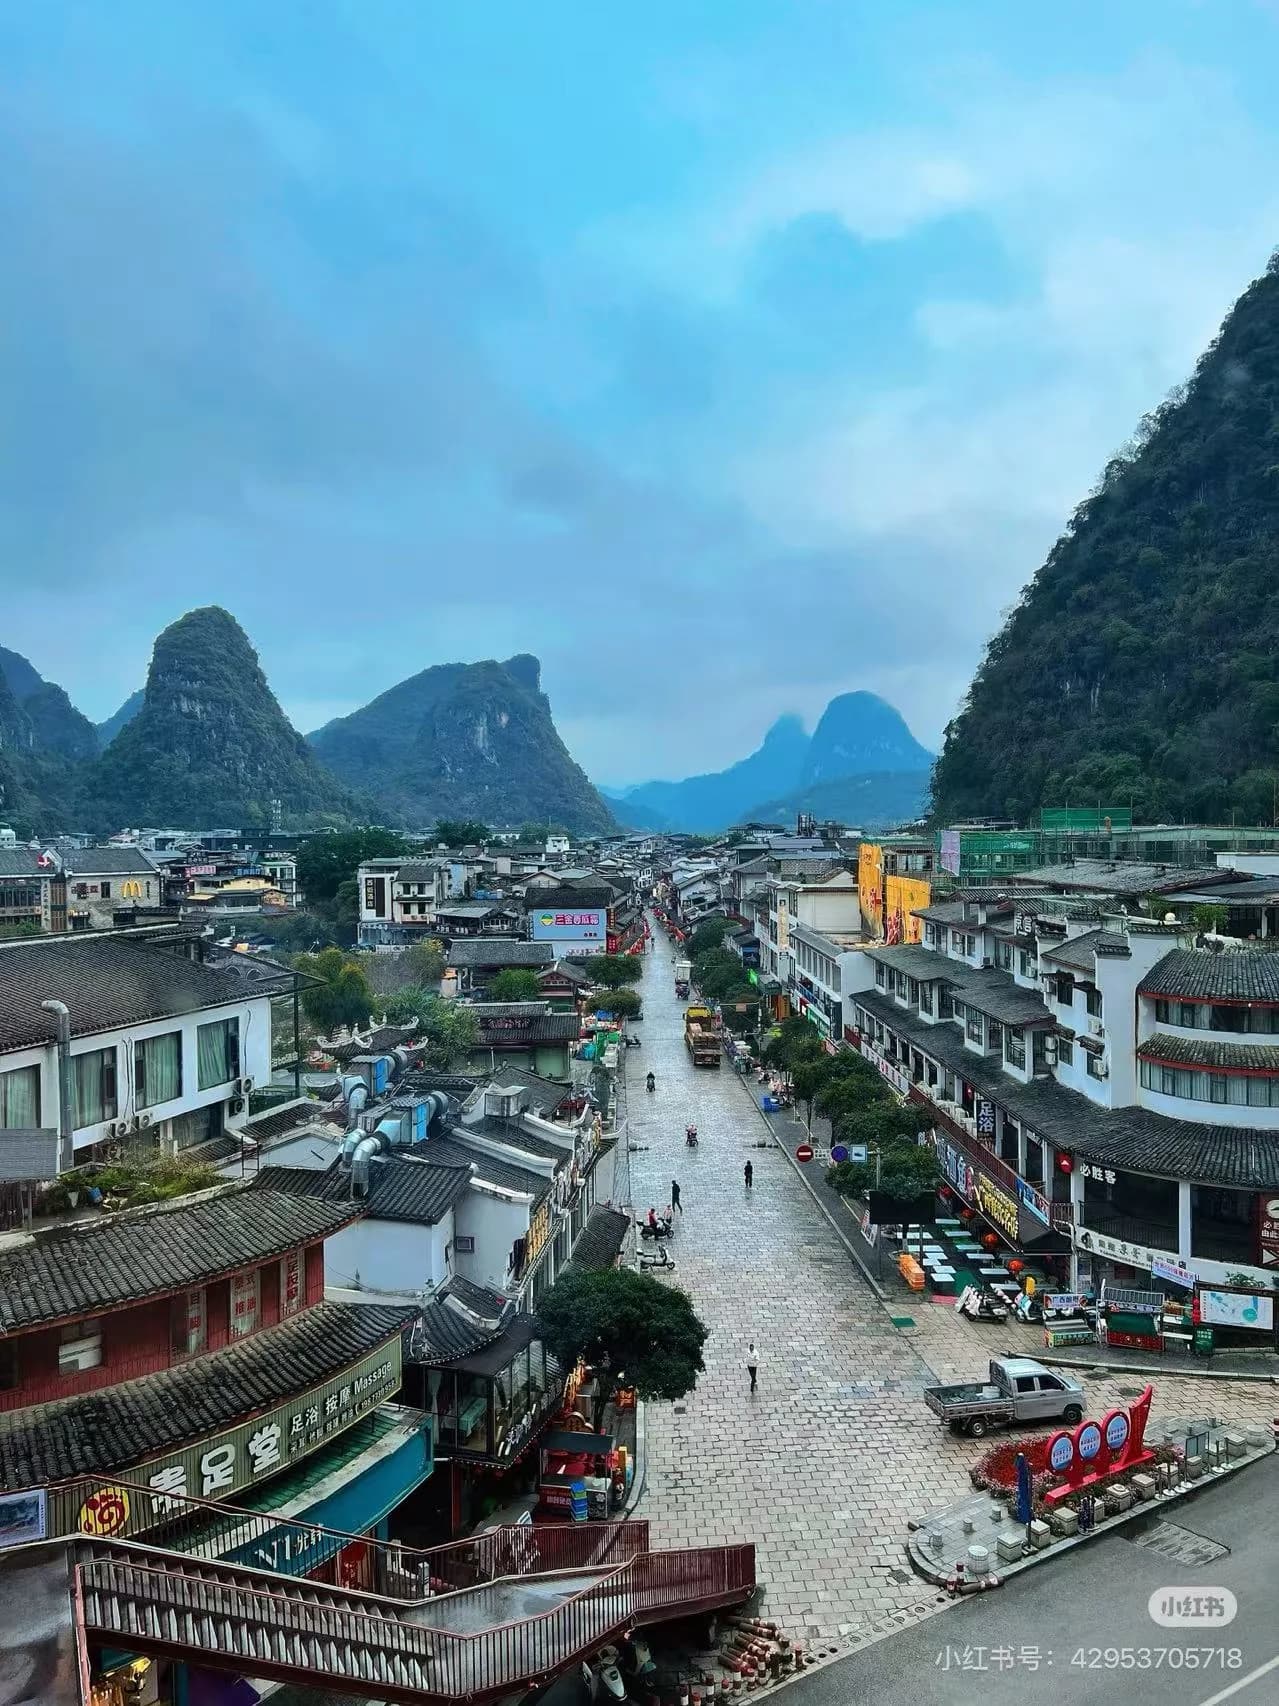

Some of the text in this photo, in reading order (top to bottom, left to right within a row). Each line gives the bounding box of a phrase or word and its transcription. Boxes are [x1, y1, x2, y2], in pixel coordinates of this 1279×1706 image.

[979, 1101, 995, 1132] 足浴
[1080, 1163, 1116, 1184] 必胜客
[290, 1361, 392, 1436] 足浴 按摩 Massage
